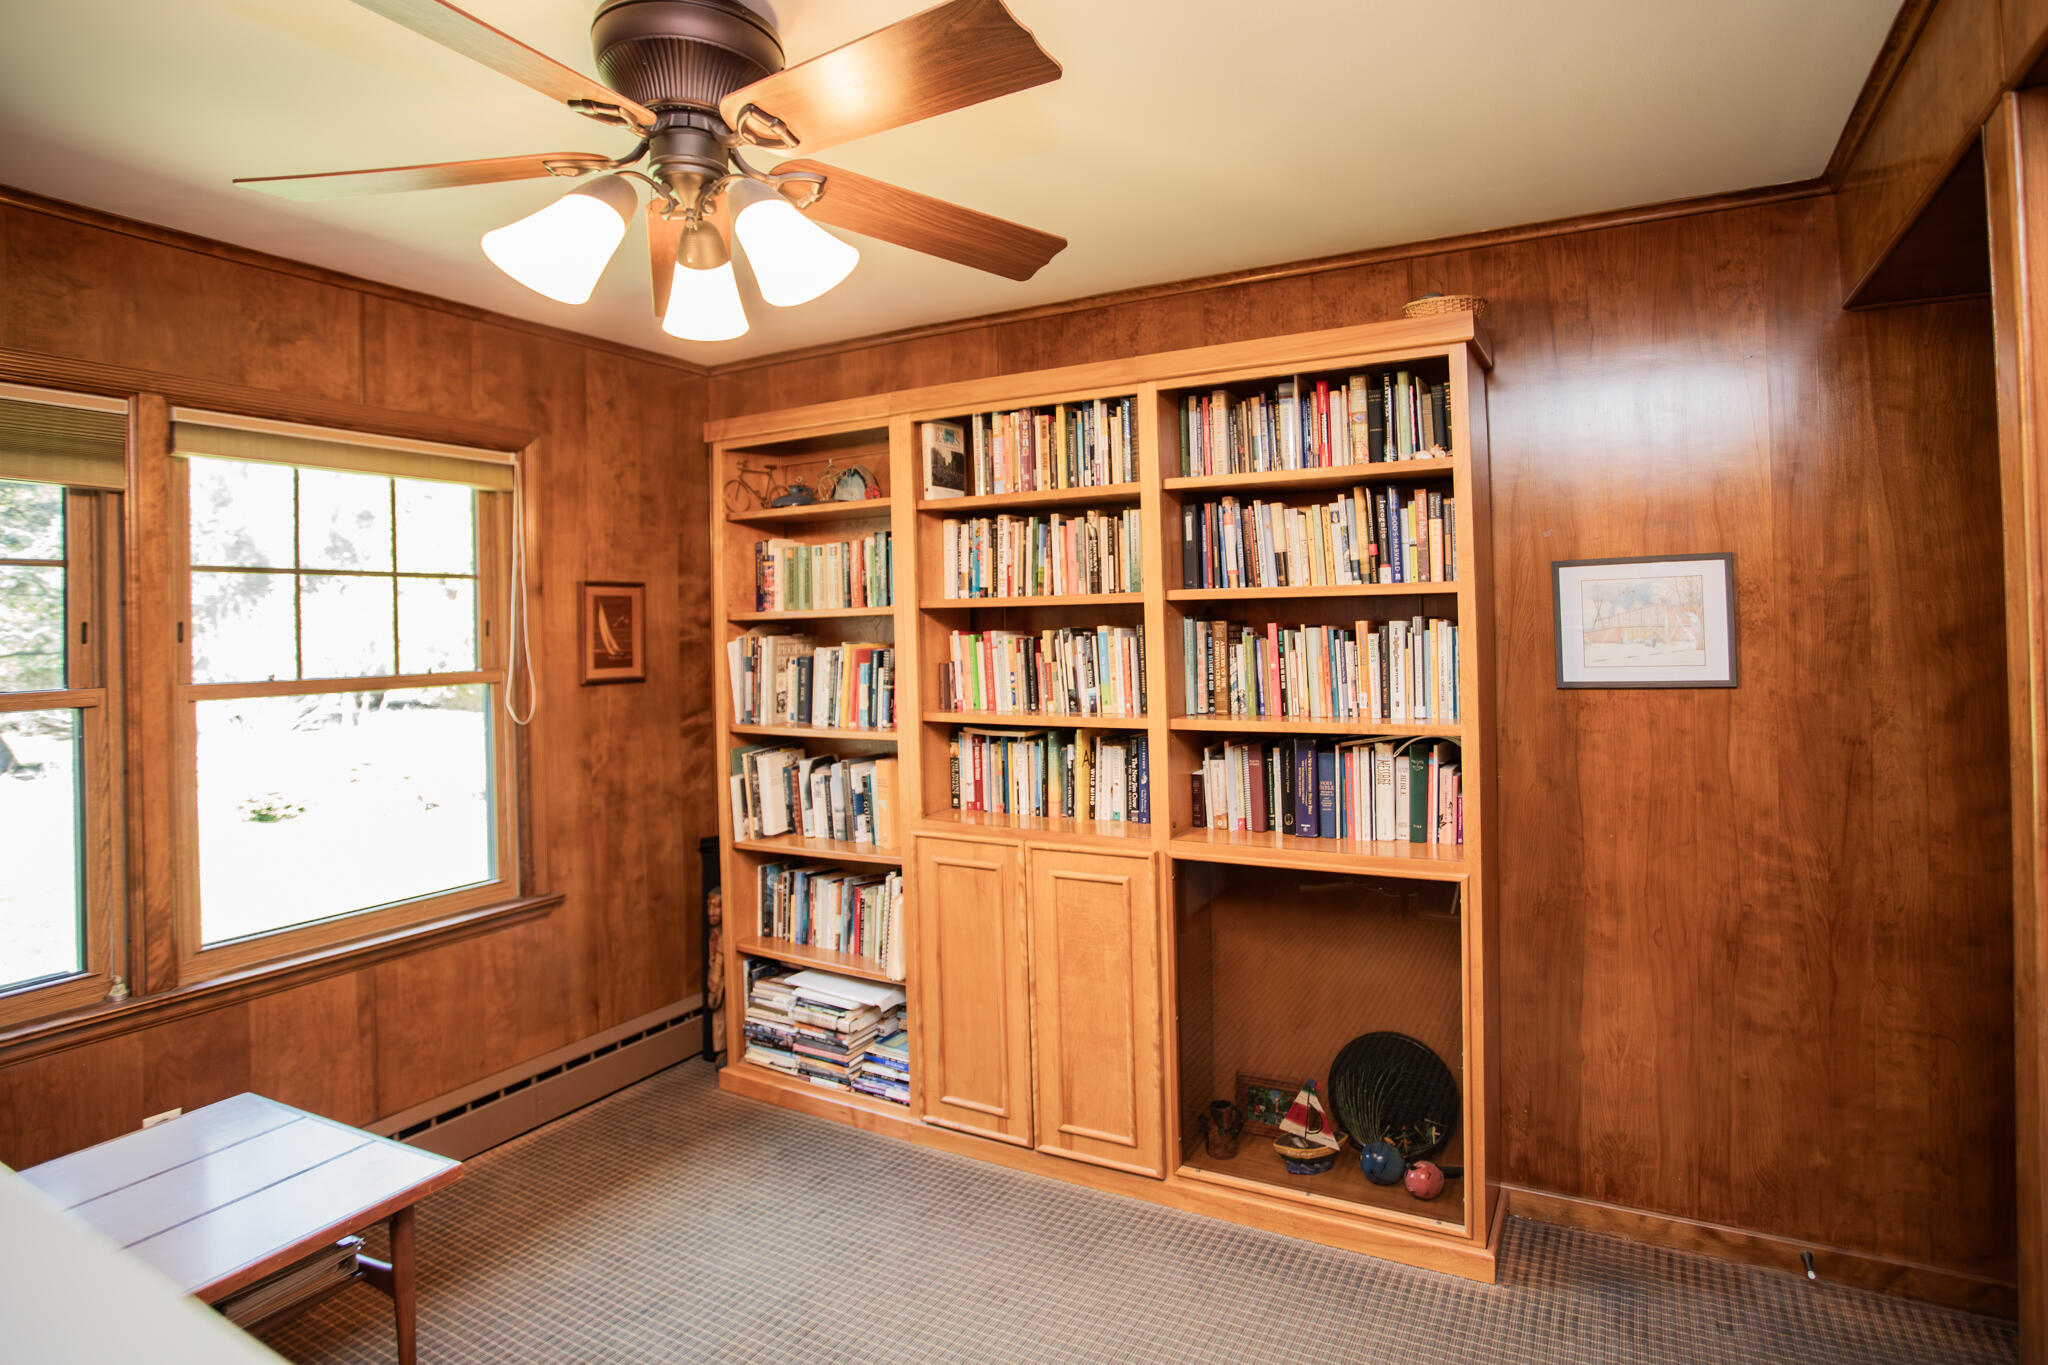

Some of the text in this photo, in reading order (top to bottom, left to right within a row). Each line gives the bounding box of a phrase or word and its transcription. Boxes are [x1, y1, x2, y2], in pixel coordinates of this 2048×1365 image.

[1379, 500, 1387, 539] Incognito
[1393, 538, 1401, 572] HARVARD
[1377, 759, 1391, 786] MESSAGE
